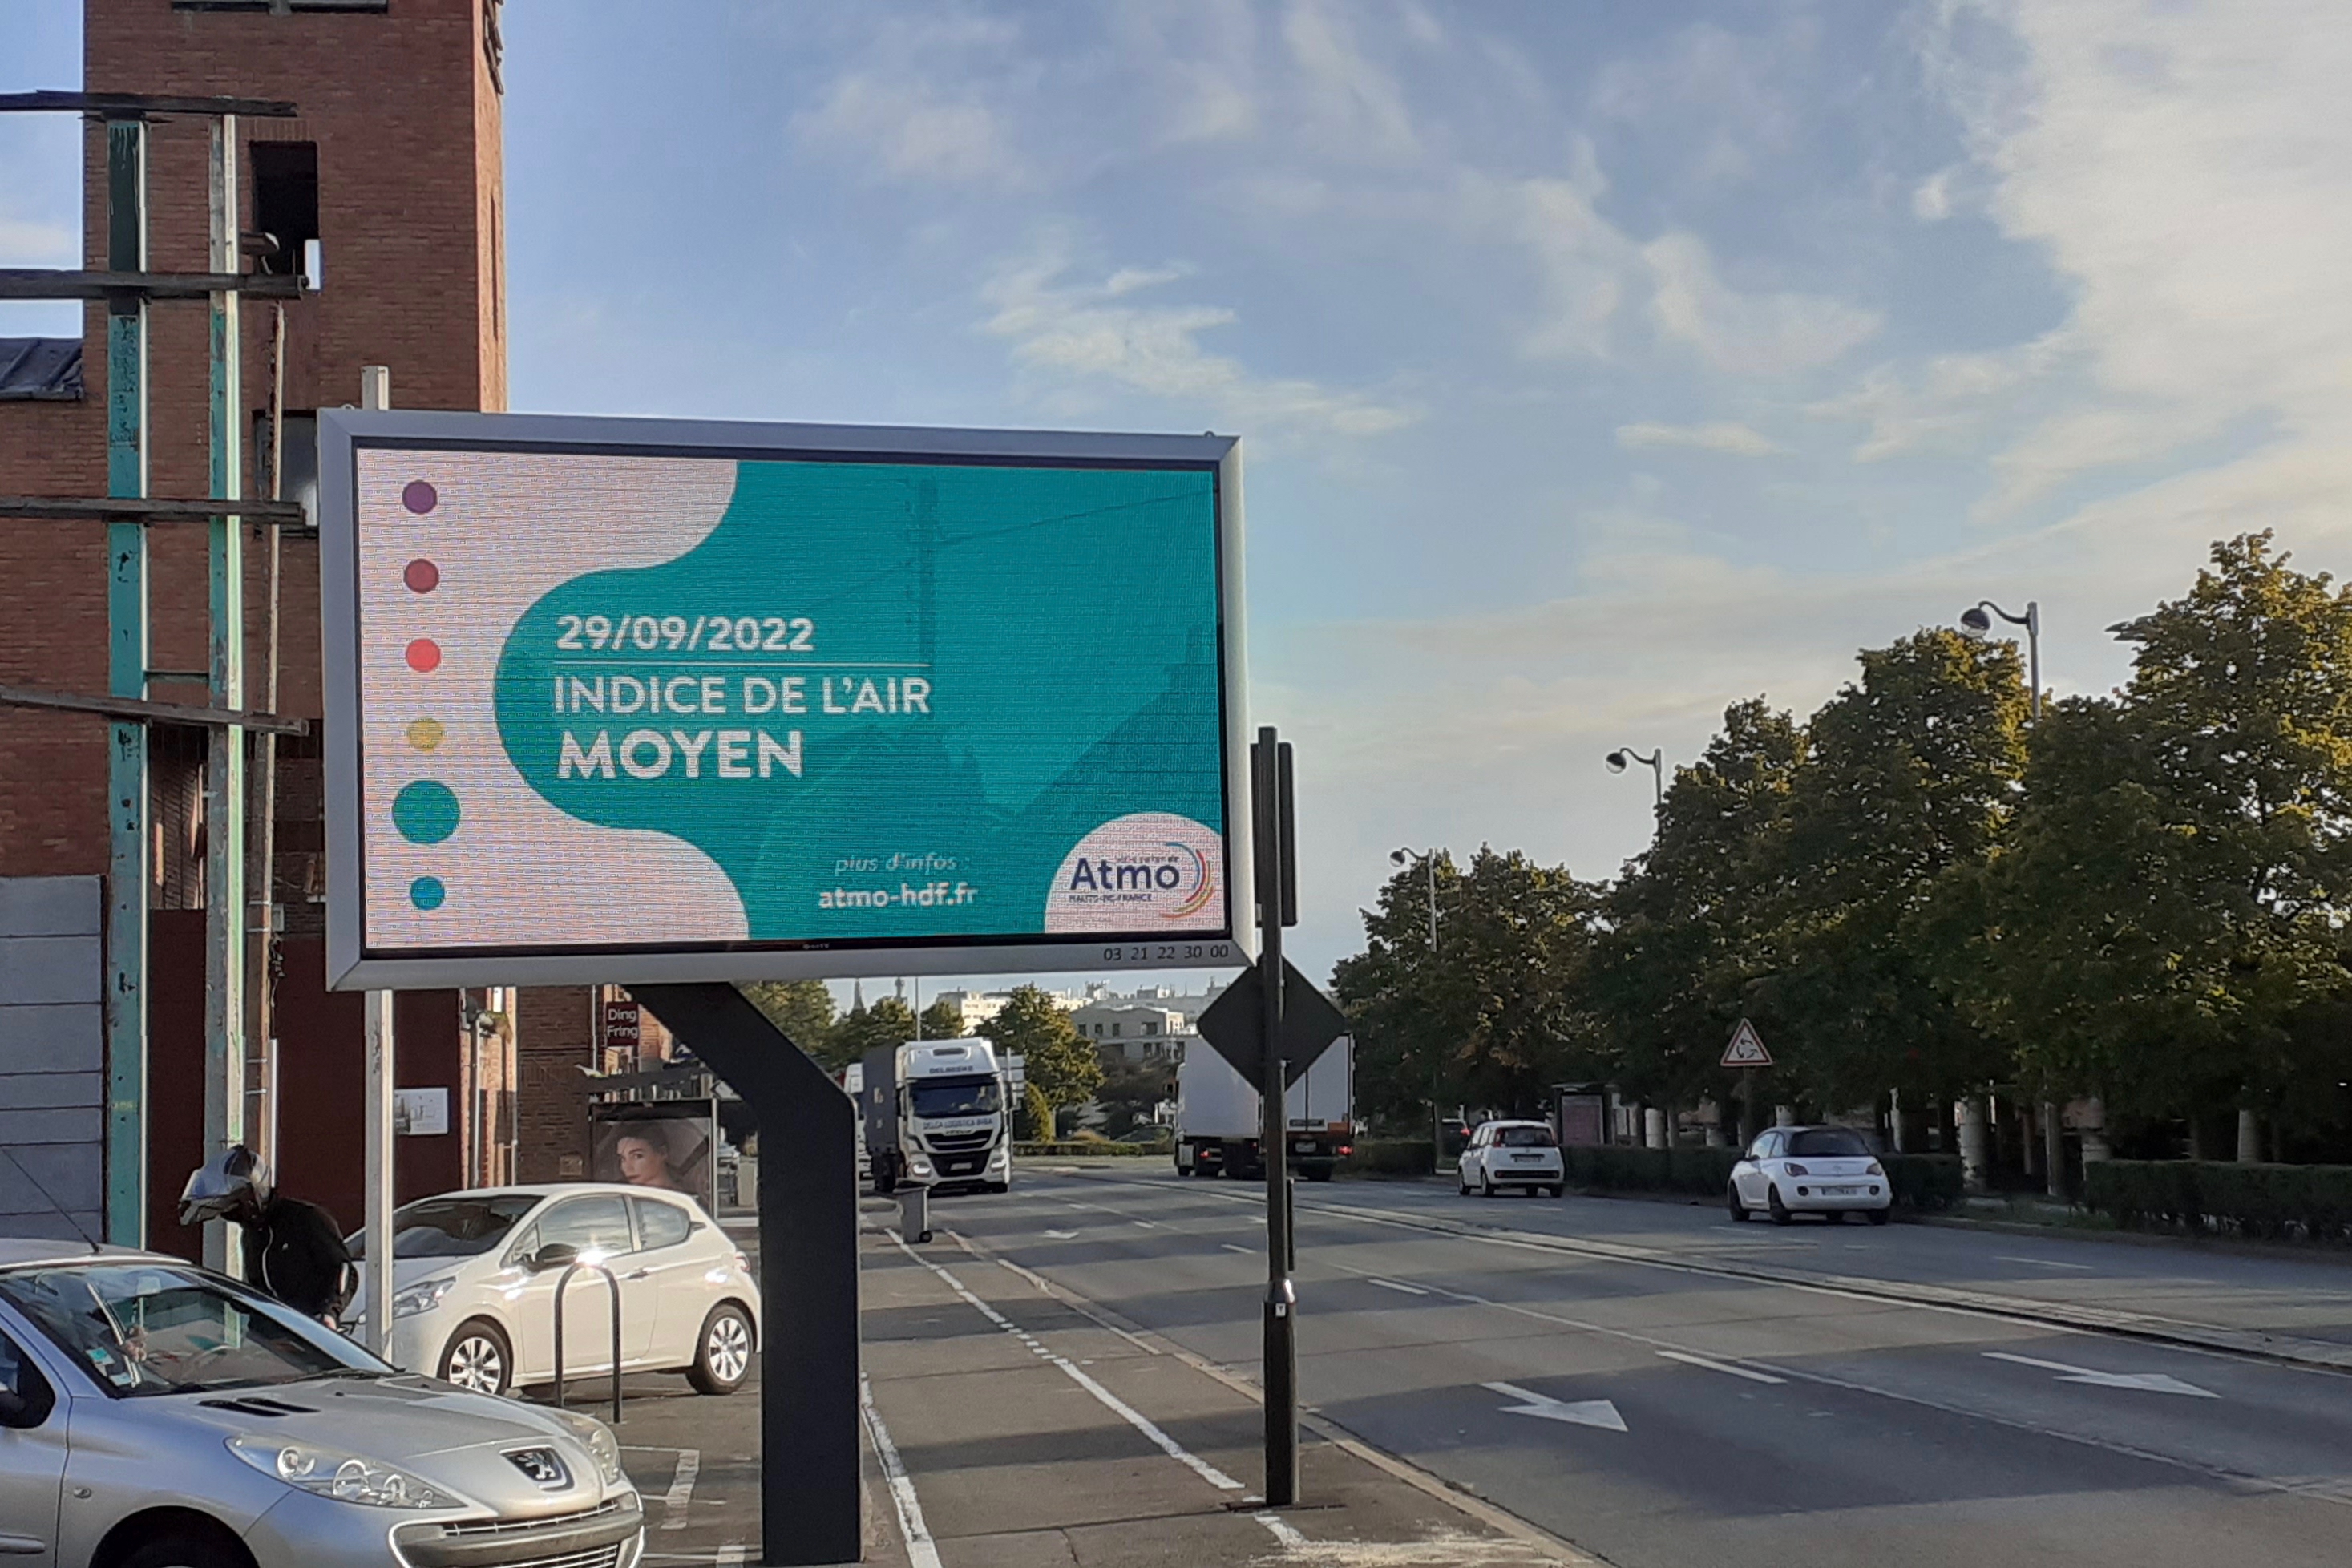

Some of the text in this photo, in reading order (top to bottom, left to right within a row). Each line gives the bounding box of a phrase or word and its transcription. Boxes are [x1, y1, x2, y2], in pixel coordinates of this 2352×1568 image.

[556, 615, 815, 651] 29/09/2022
[553, 675, 932, 714] INDICE DE L'AIR
[557, 730, 802, 779] MOYEN
[1069, 857, 1180, 891] Atmo
[818, 881, 979, 909] atmo-hdf.fr
[1103, 944, 1229, 960] 03 21 22 30 00
[608, 1008, 636, 1023] Ding
[608, 1025, 638, 1039] Fring
